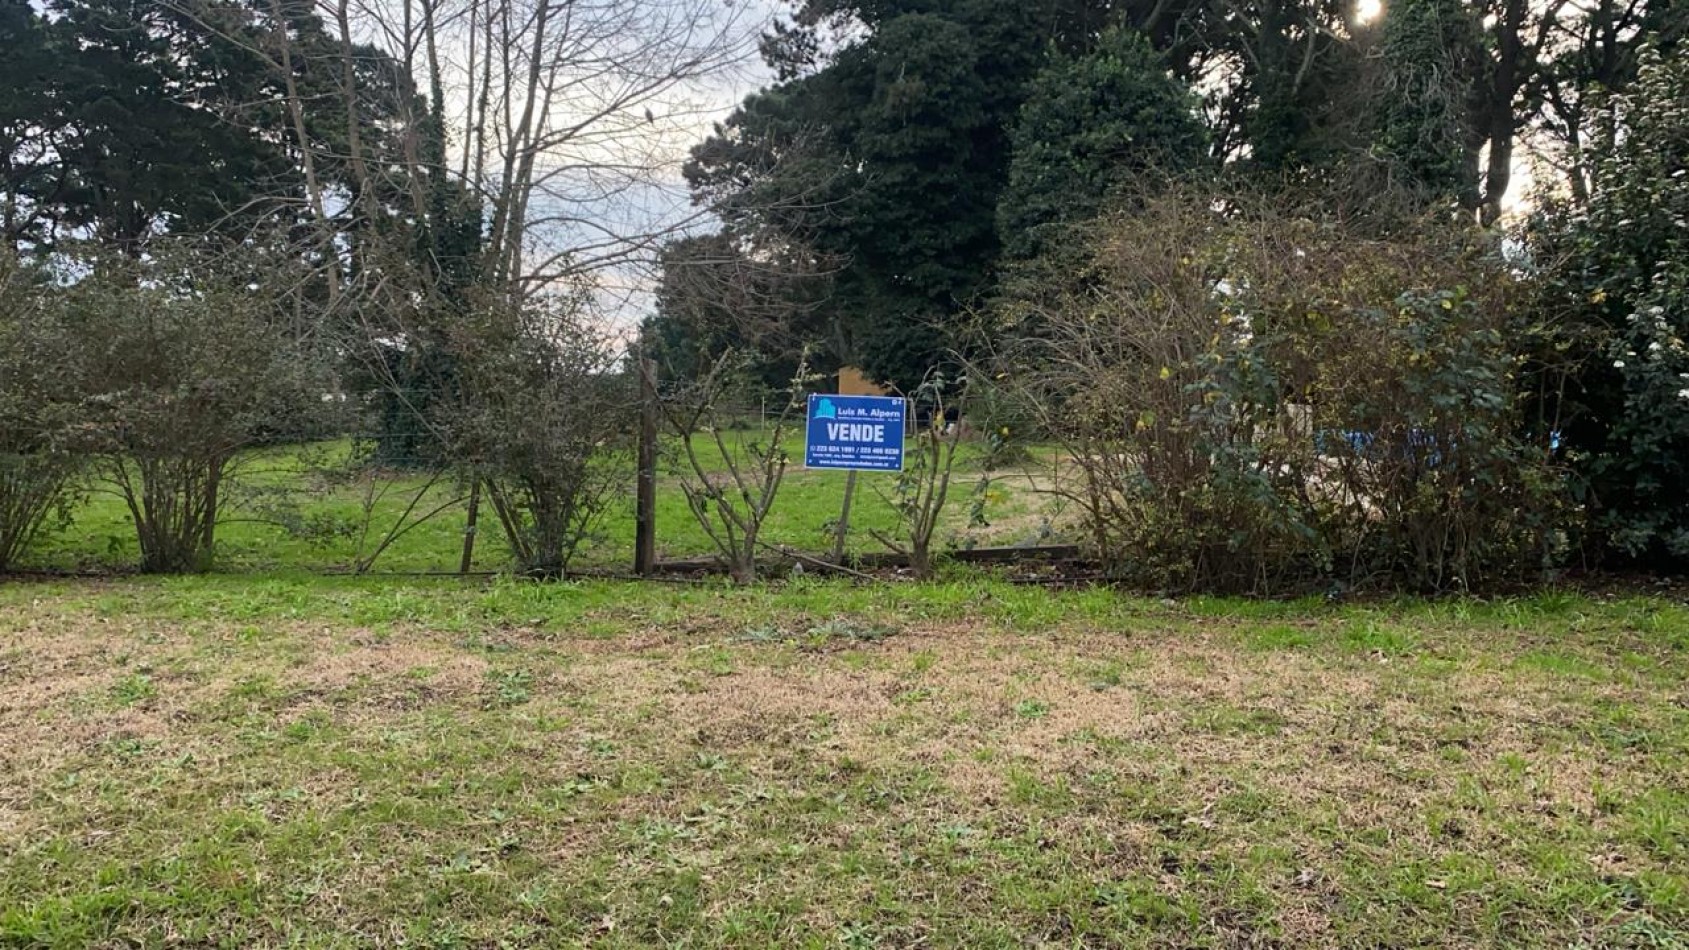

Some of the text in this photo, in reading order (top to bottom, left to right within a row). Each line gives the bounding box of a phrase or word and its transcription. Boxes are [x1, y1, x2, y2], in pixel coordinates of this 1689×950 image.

[838, 407, 855, 416] Luis
[857, 408, 868, 417] M.
[827, 422, 885, 443] VENDE
